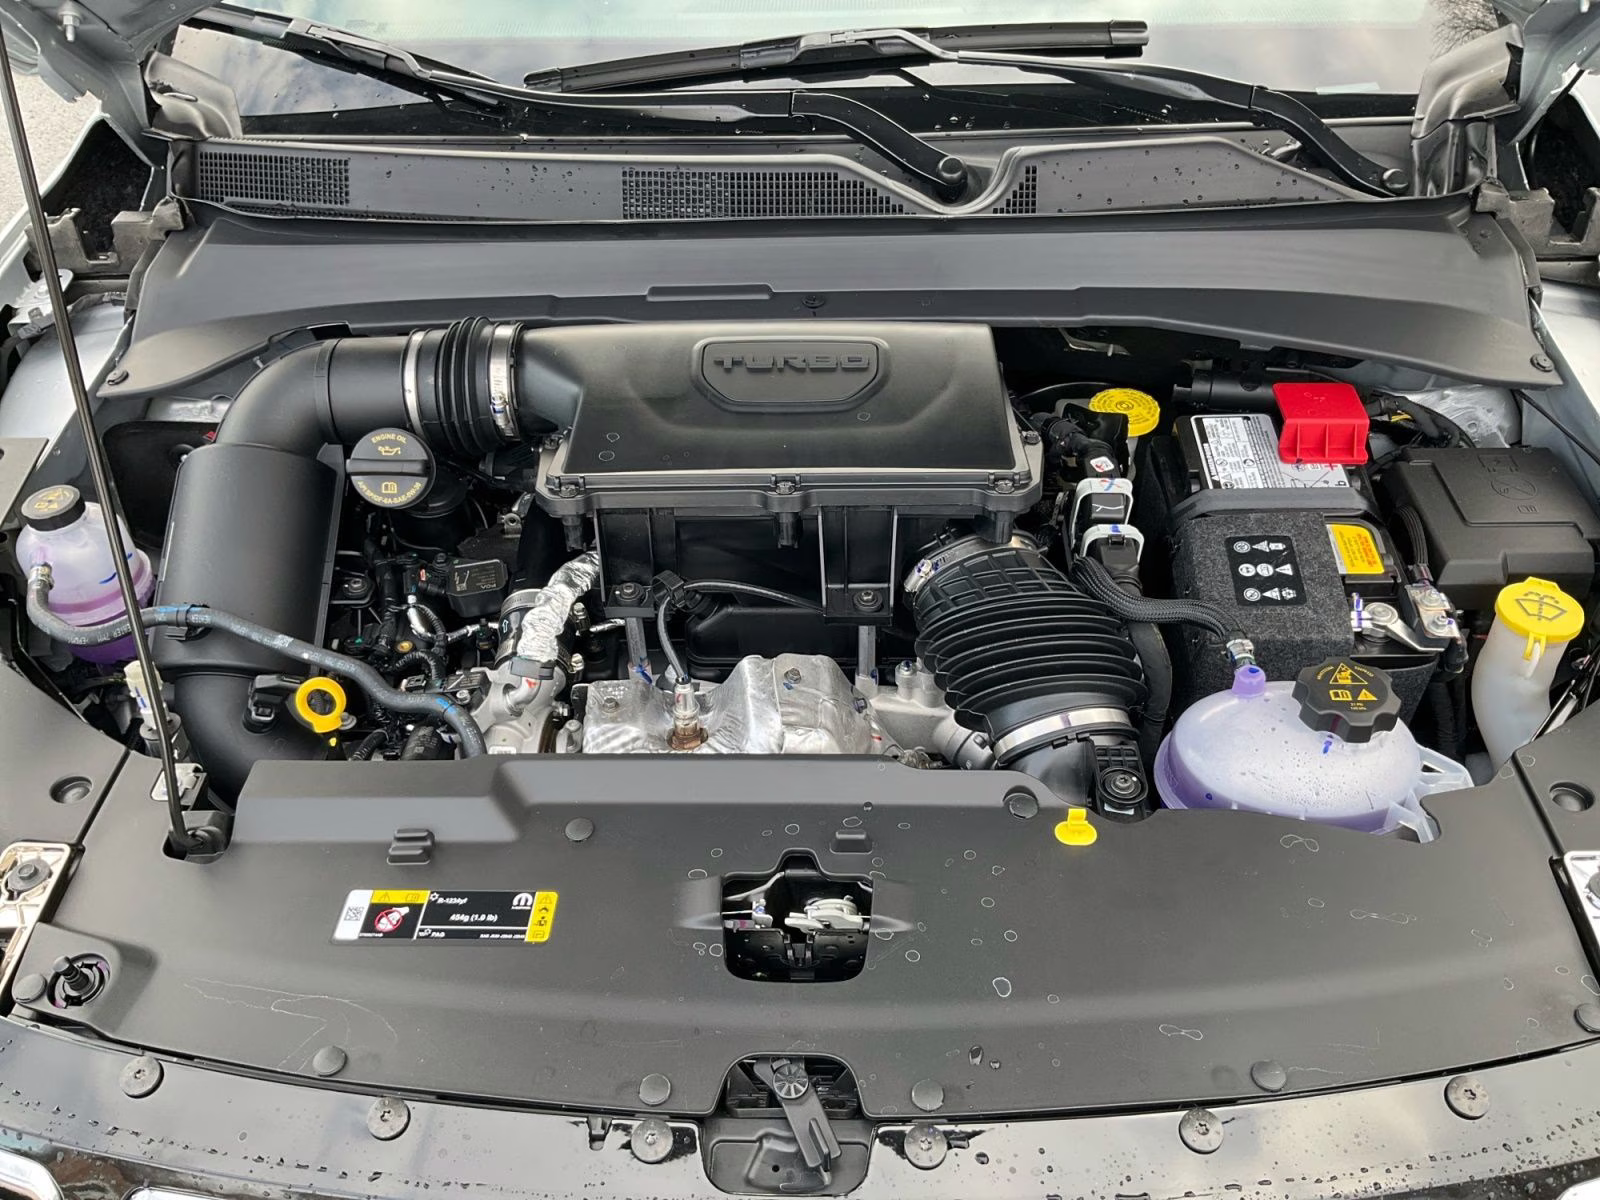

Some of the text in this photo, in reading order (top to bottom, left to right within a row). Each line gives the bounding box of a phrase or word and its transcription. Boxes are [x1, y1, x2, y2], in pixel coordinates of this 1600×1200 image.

[713, 353, 870, 372] TURBO
[371, 433, 407, 444] ENGINE OIL
[437, 897, 468, 905] R-1234yf
[449, 913, 498, 923] 454g (1.0 lb)
